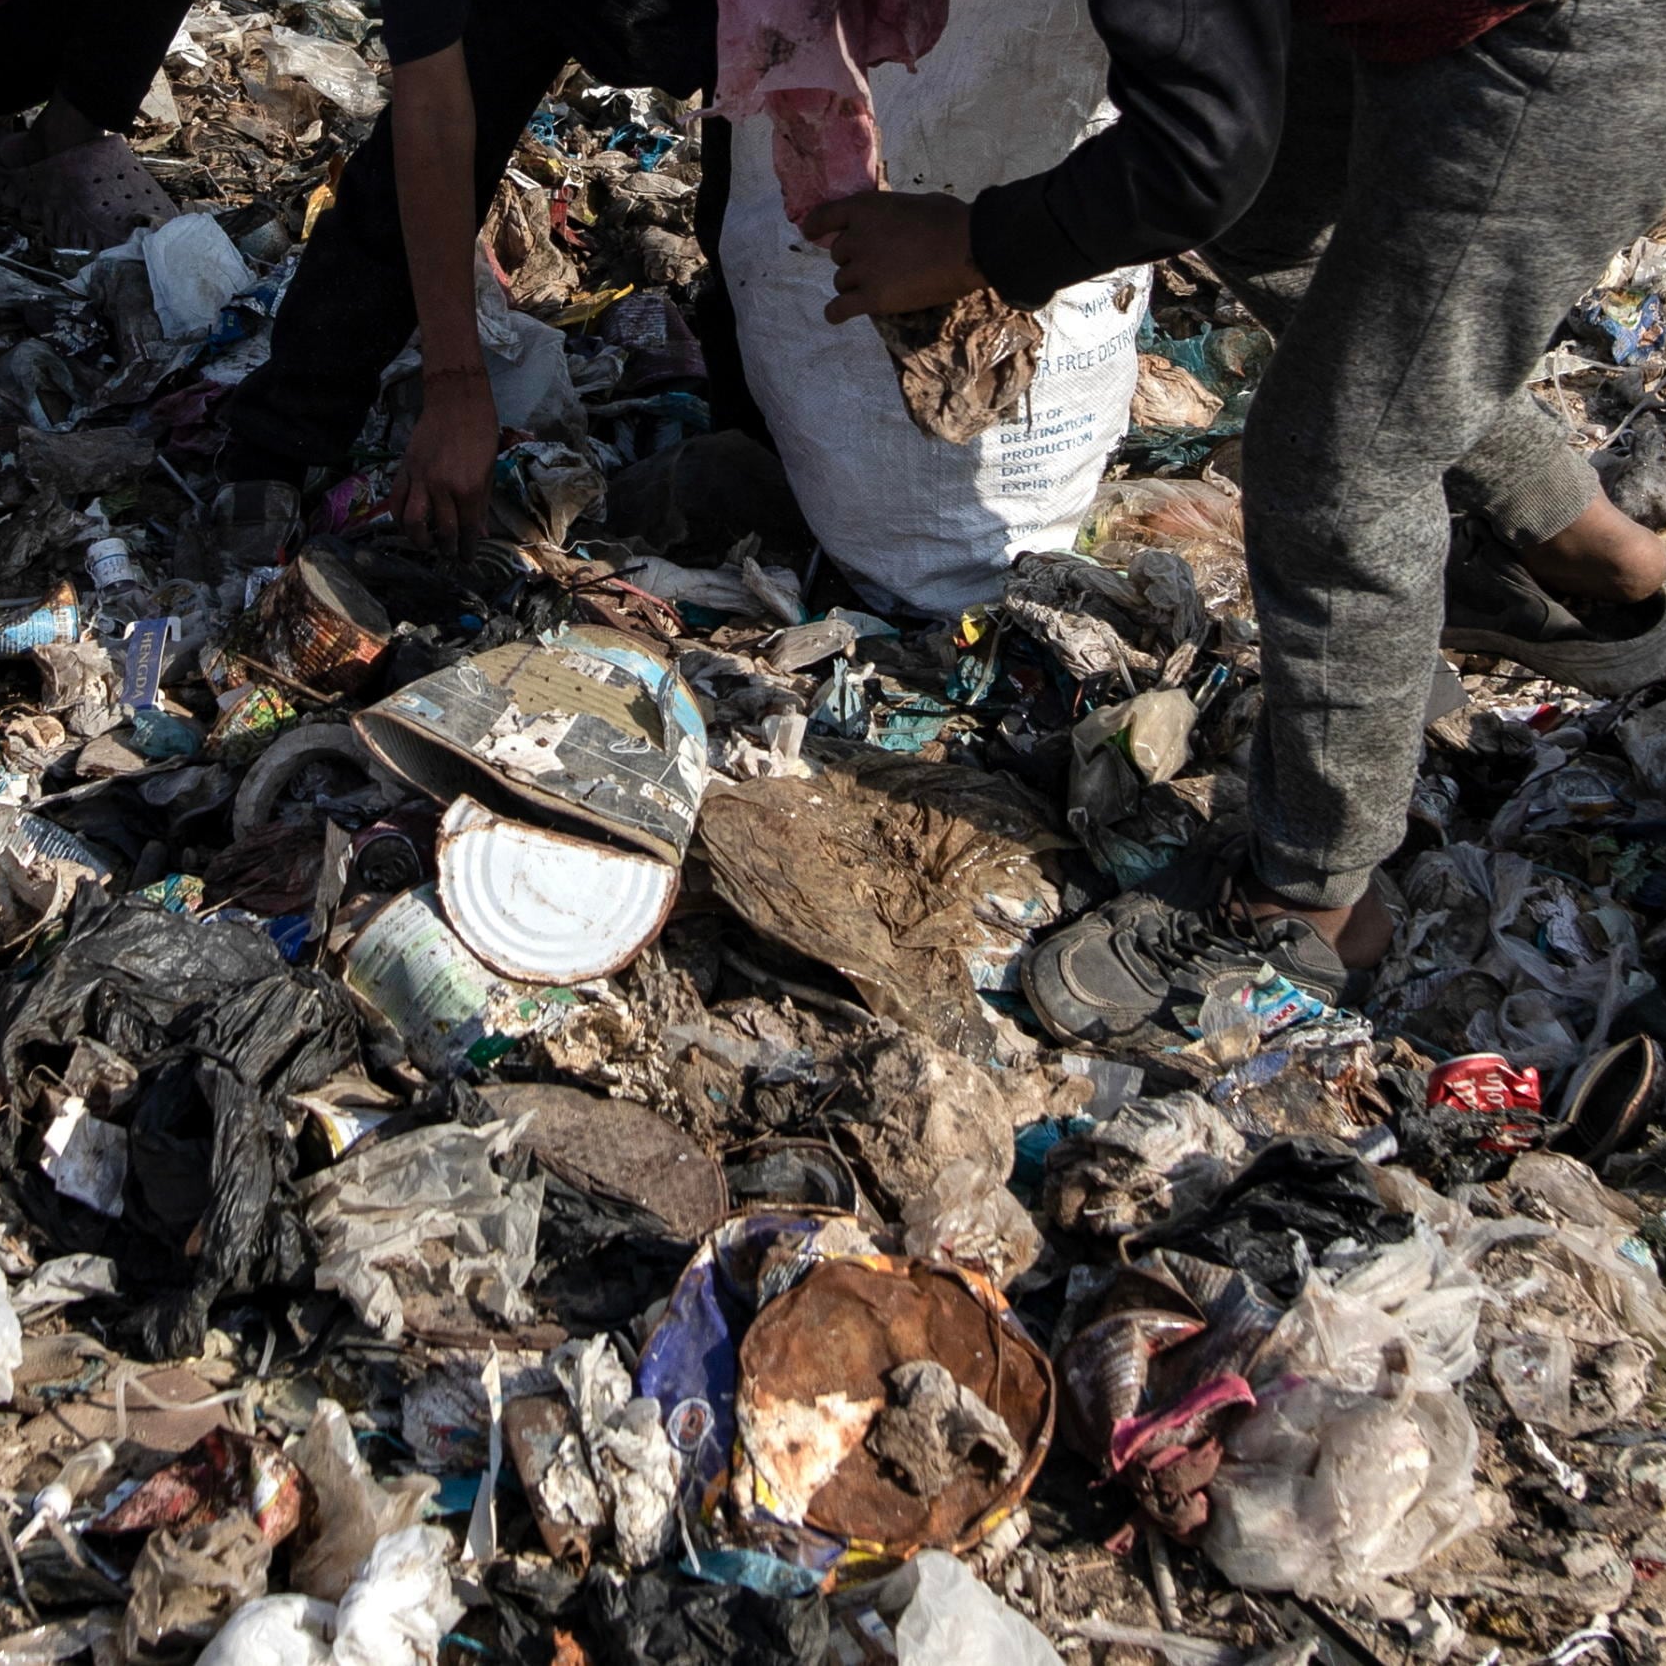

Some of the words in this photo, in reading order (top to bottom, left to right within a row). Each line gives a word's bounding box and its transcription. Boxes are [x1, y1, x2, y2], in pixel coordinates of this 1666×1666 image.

[1056, 349, 1096, 374] FREE
[1046, 405, 1063, 420] OF
[1000, 413, 1096, 444] DESTINATION:
[1001, 430, 1093, 462] PRODUCTION
[1001, 479, 1055, 493] EXPIRY
[132, 631, 154, 700] HENGDA
